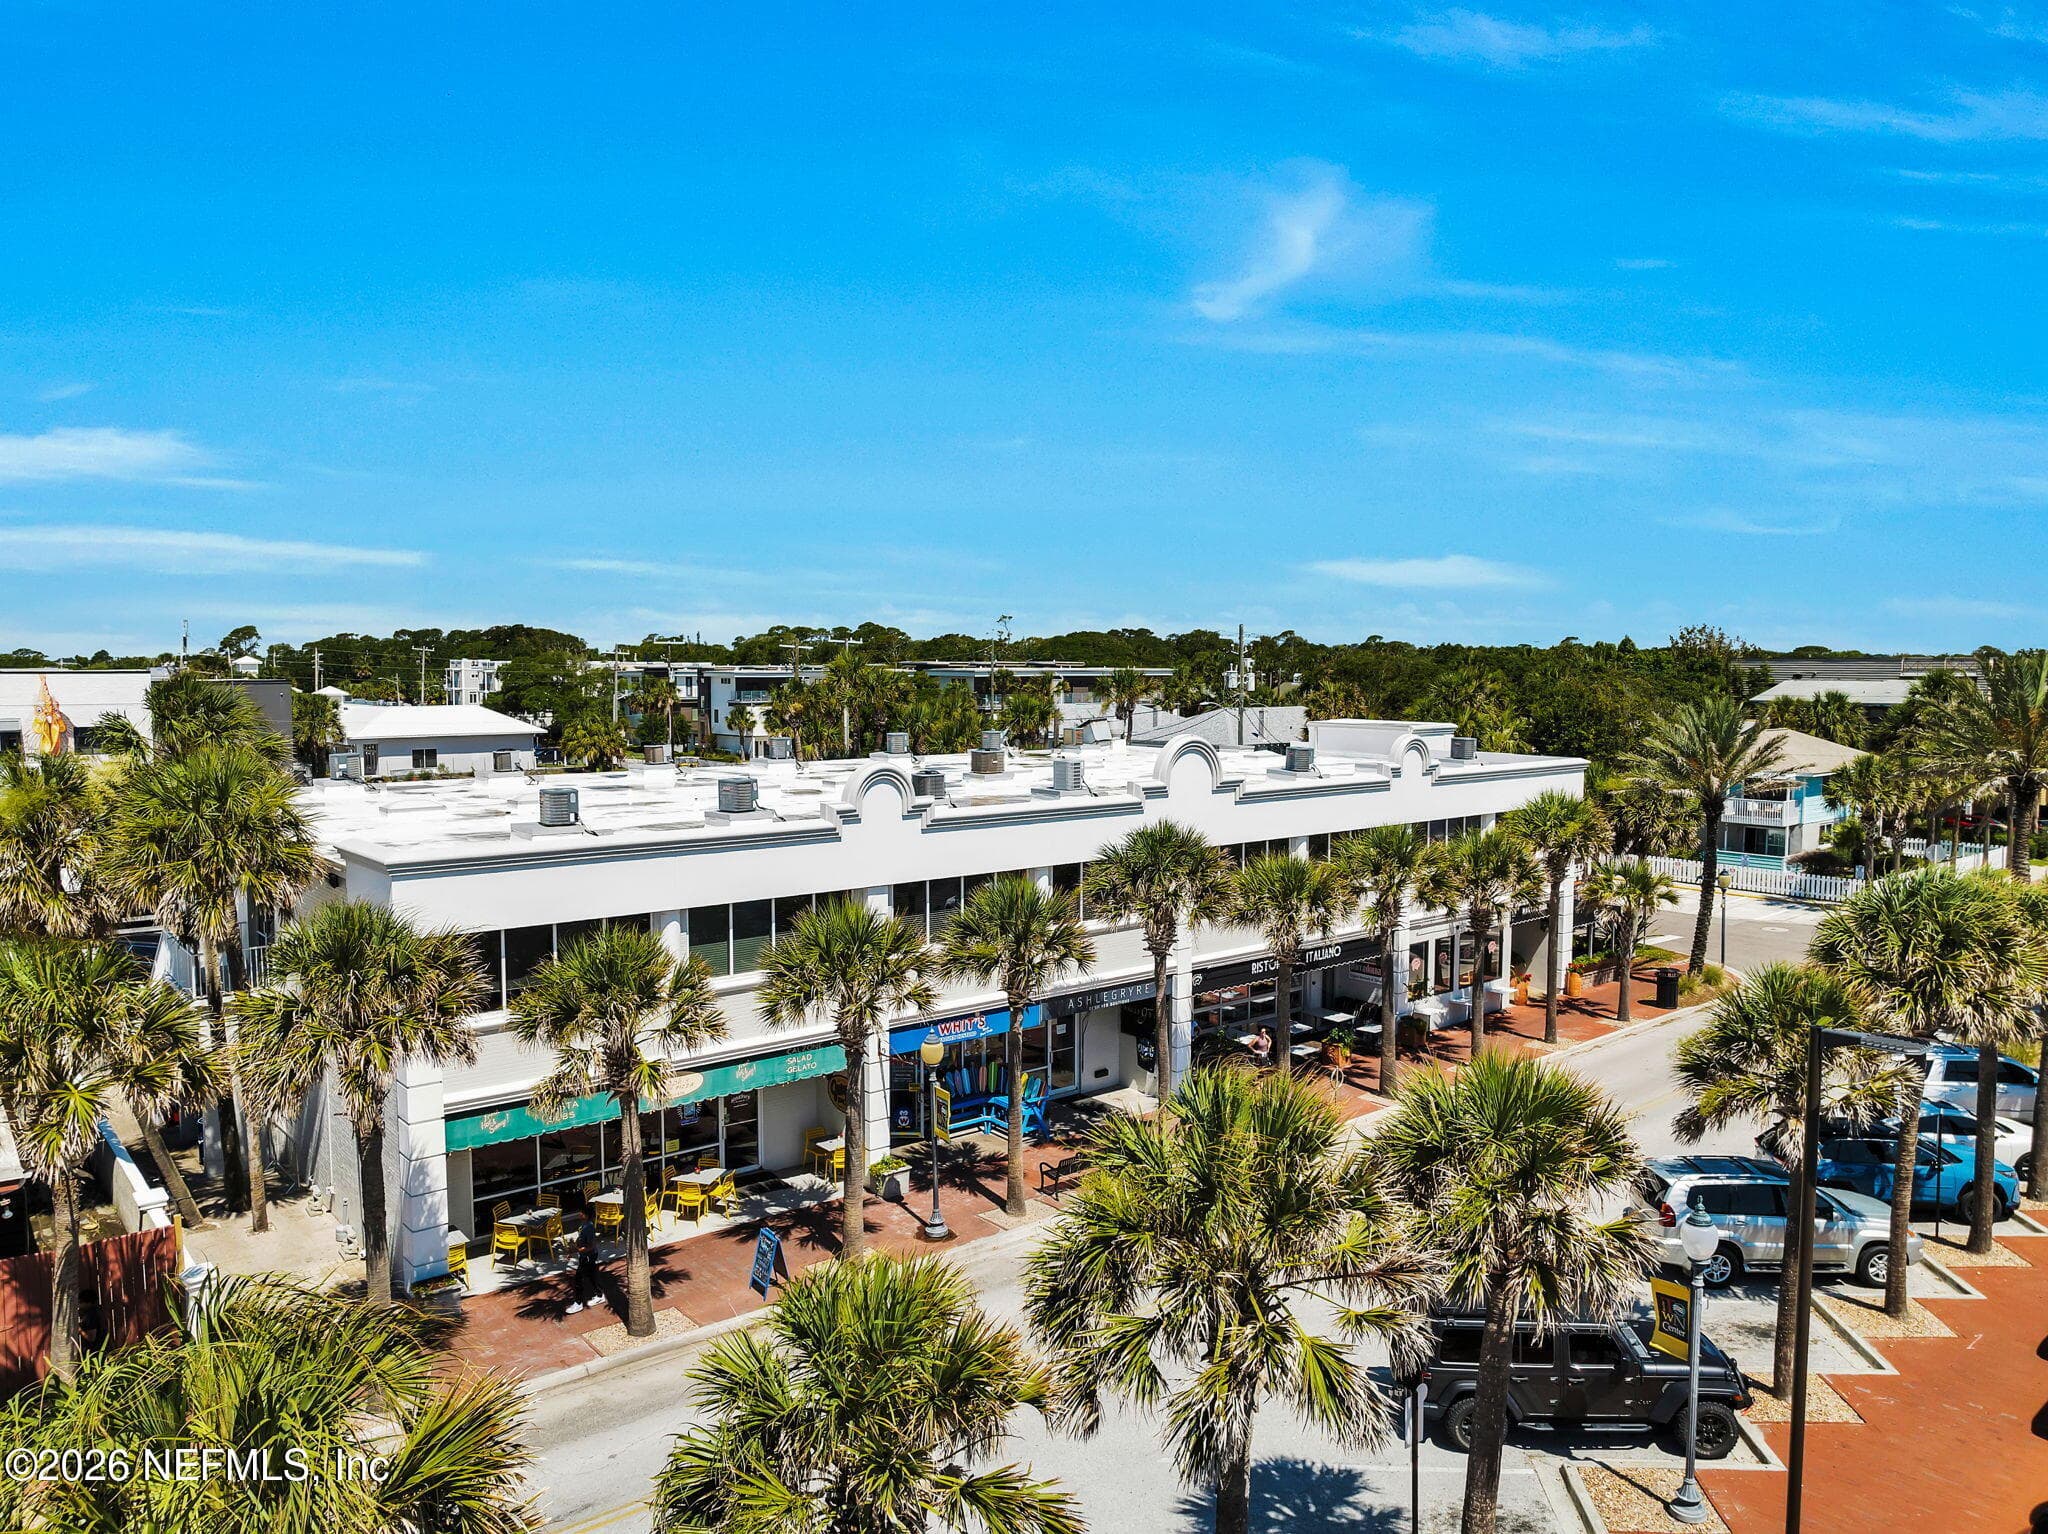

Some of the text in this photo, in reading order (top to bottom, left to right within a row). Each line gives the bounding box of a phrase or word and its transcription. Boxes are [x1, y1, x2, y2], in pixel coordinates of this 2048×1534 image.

[1305, 945, 1342, 963] ITALIANO
[1067, 983, 1151, 1009] ASHLEGRYRE
[938, 1015, 986, 1037] WHIT'S
[786, 1053, 813, 1065] SALAD
[786, 1061, 817, 1074] GELATO
[1662, 1321, 1686, 1337] Center
